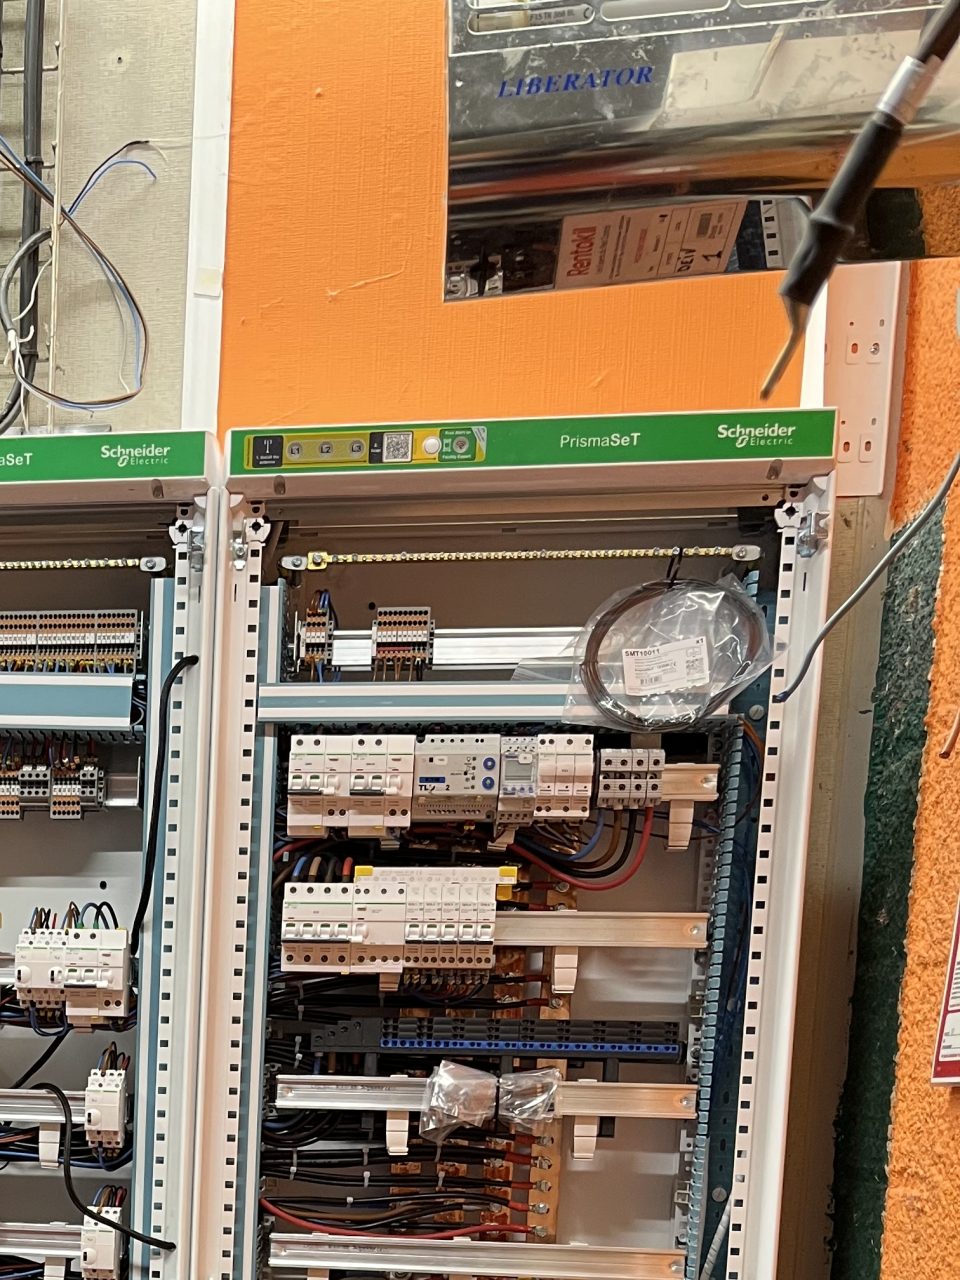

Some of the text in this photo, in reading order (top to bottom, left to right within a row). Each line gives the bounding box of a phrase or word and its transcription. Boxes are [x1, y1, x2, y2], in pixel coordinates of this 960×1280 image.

[498, 66, 653, 97] LIBERATOR
[567, 226, 597, 277] Rentokil
[717, 423, 796, 439] Schneider
[560, 433, 641, 448] PrismaSeT
[750, 438, 793, 446] Electric
[101, 444, 171, 458] Schneider
[290, 447, 300, 455] L1
[320, 445, 331, 454] L2
[351, 444, 362, 453] L3
[130, 457, 168, 465] Electric
